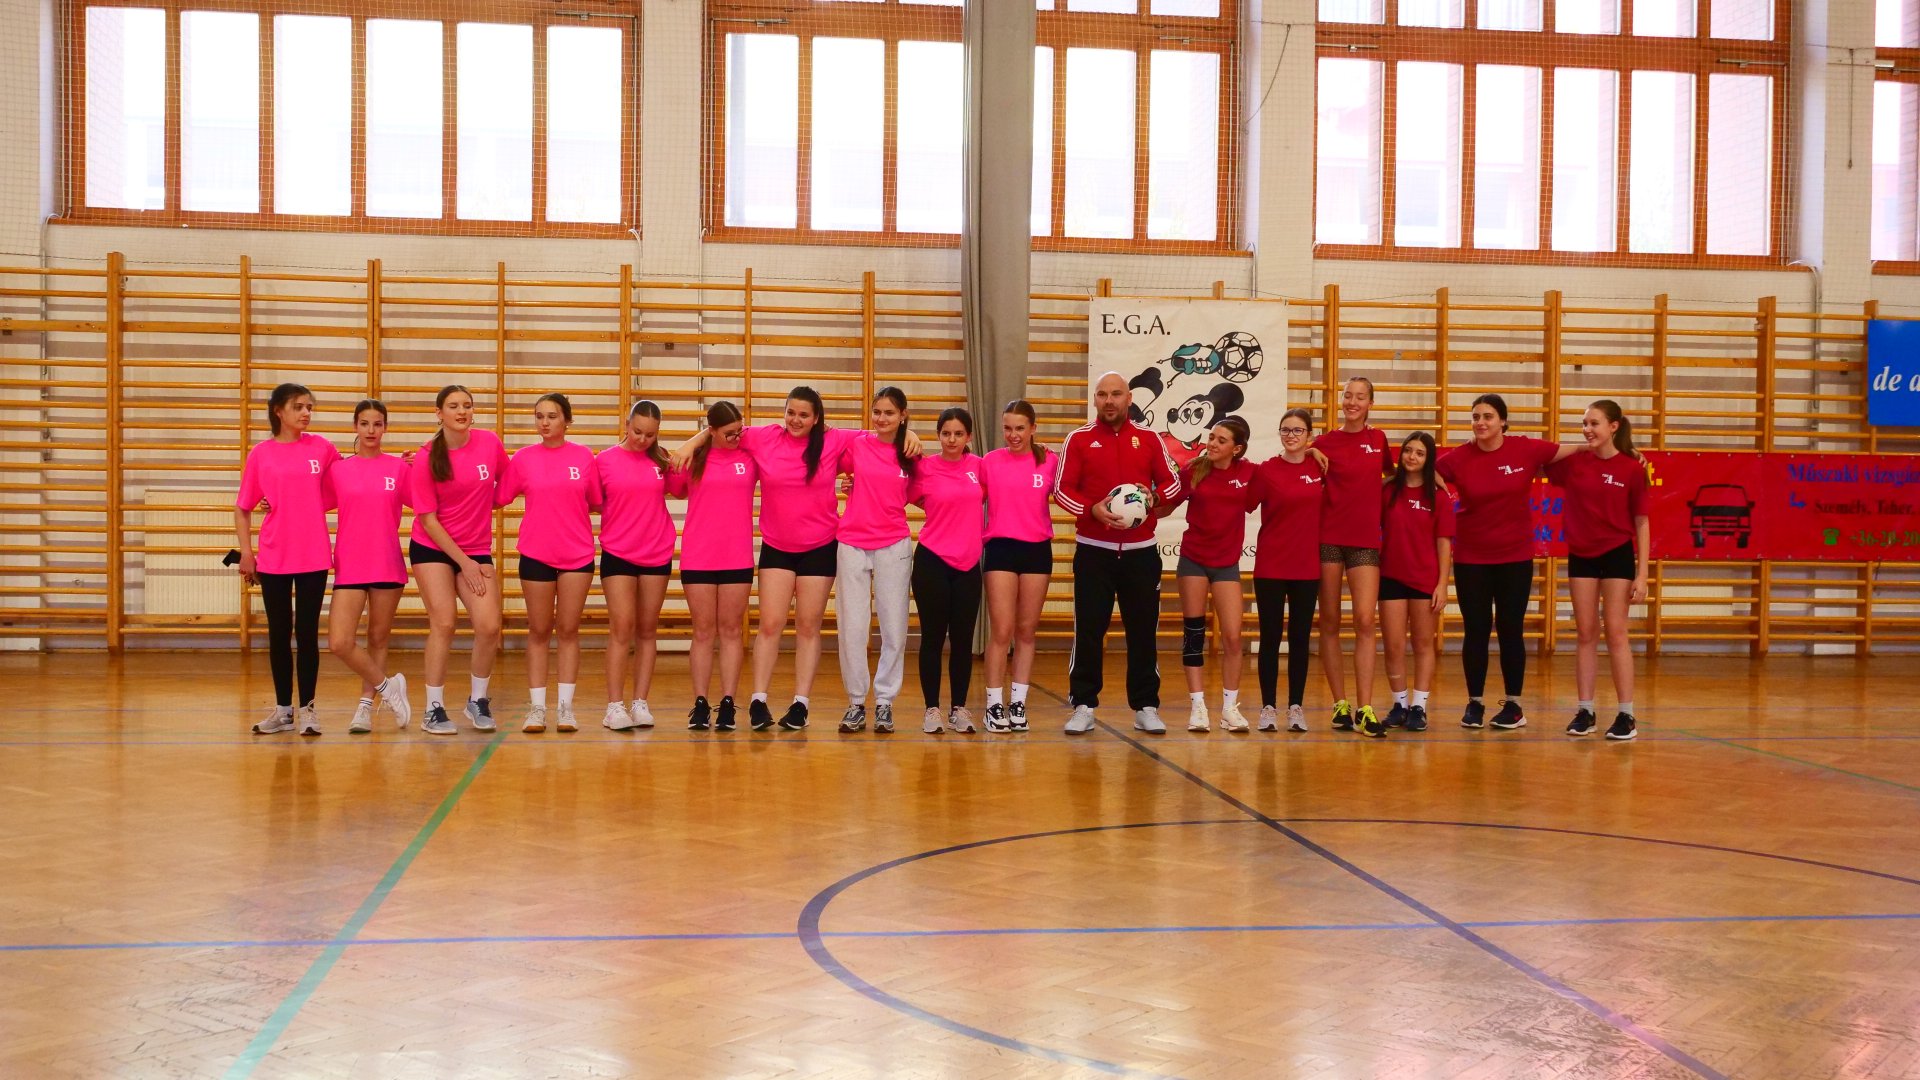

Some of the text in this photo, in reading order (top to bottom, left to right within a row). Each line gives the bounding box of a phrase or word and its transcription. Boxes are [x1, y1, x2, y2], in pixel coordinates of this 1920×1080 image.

[1101, 313, 1171, 335] E.G.A.
[1873, 366, 1902, 392] de
[308, 459, 321, 474] B
[477, 464, 490, 481] B
[568, 466, 581, 480] B
[735, 462, 746, 475] B
[1033, 474, 1044, 488] B
[1864, 464, 1920, 487] vizsgá
[384, 476, 396, 491] B
